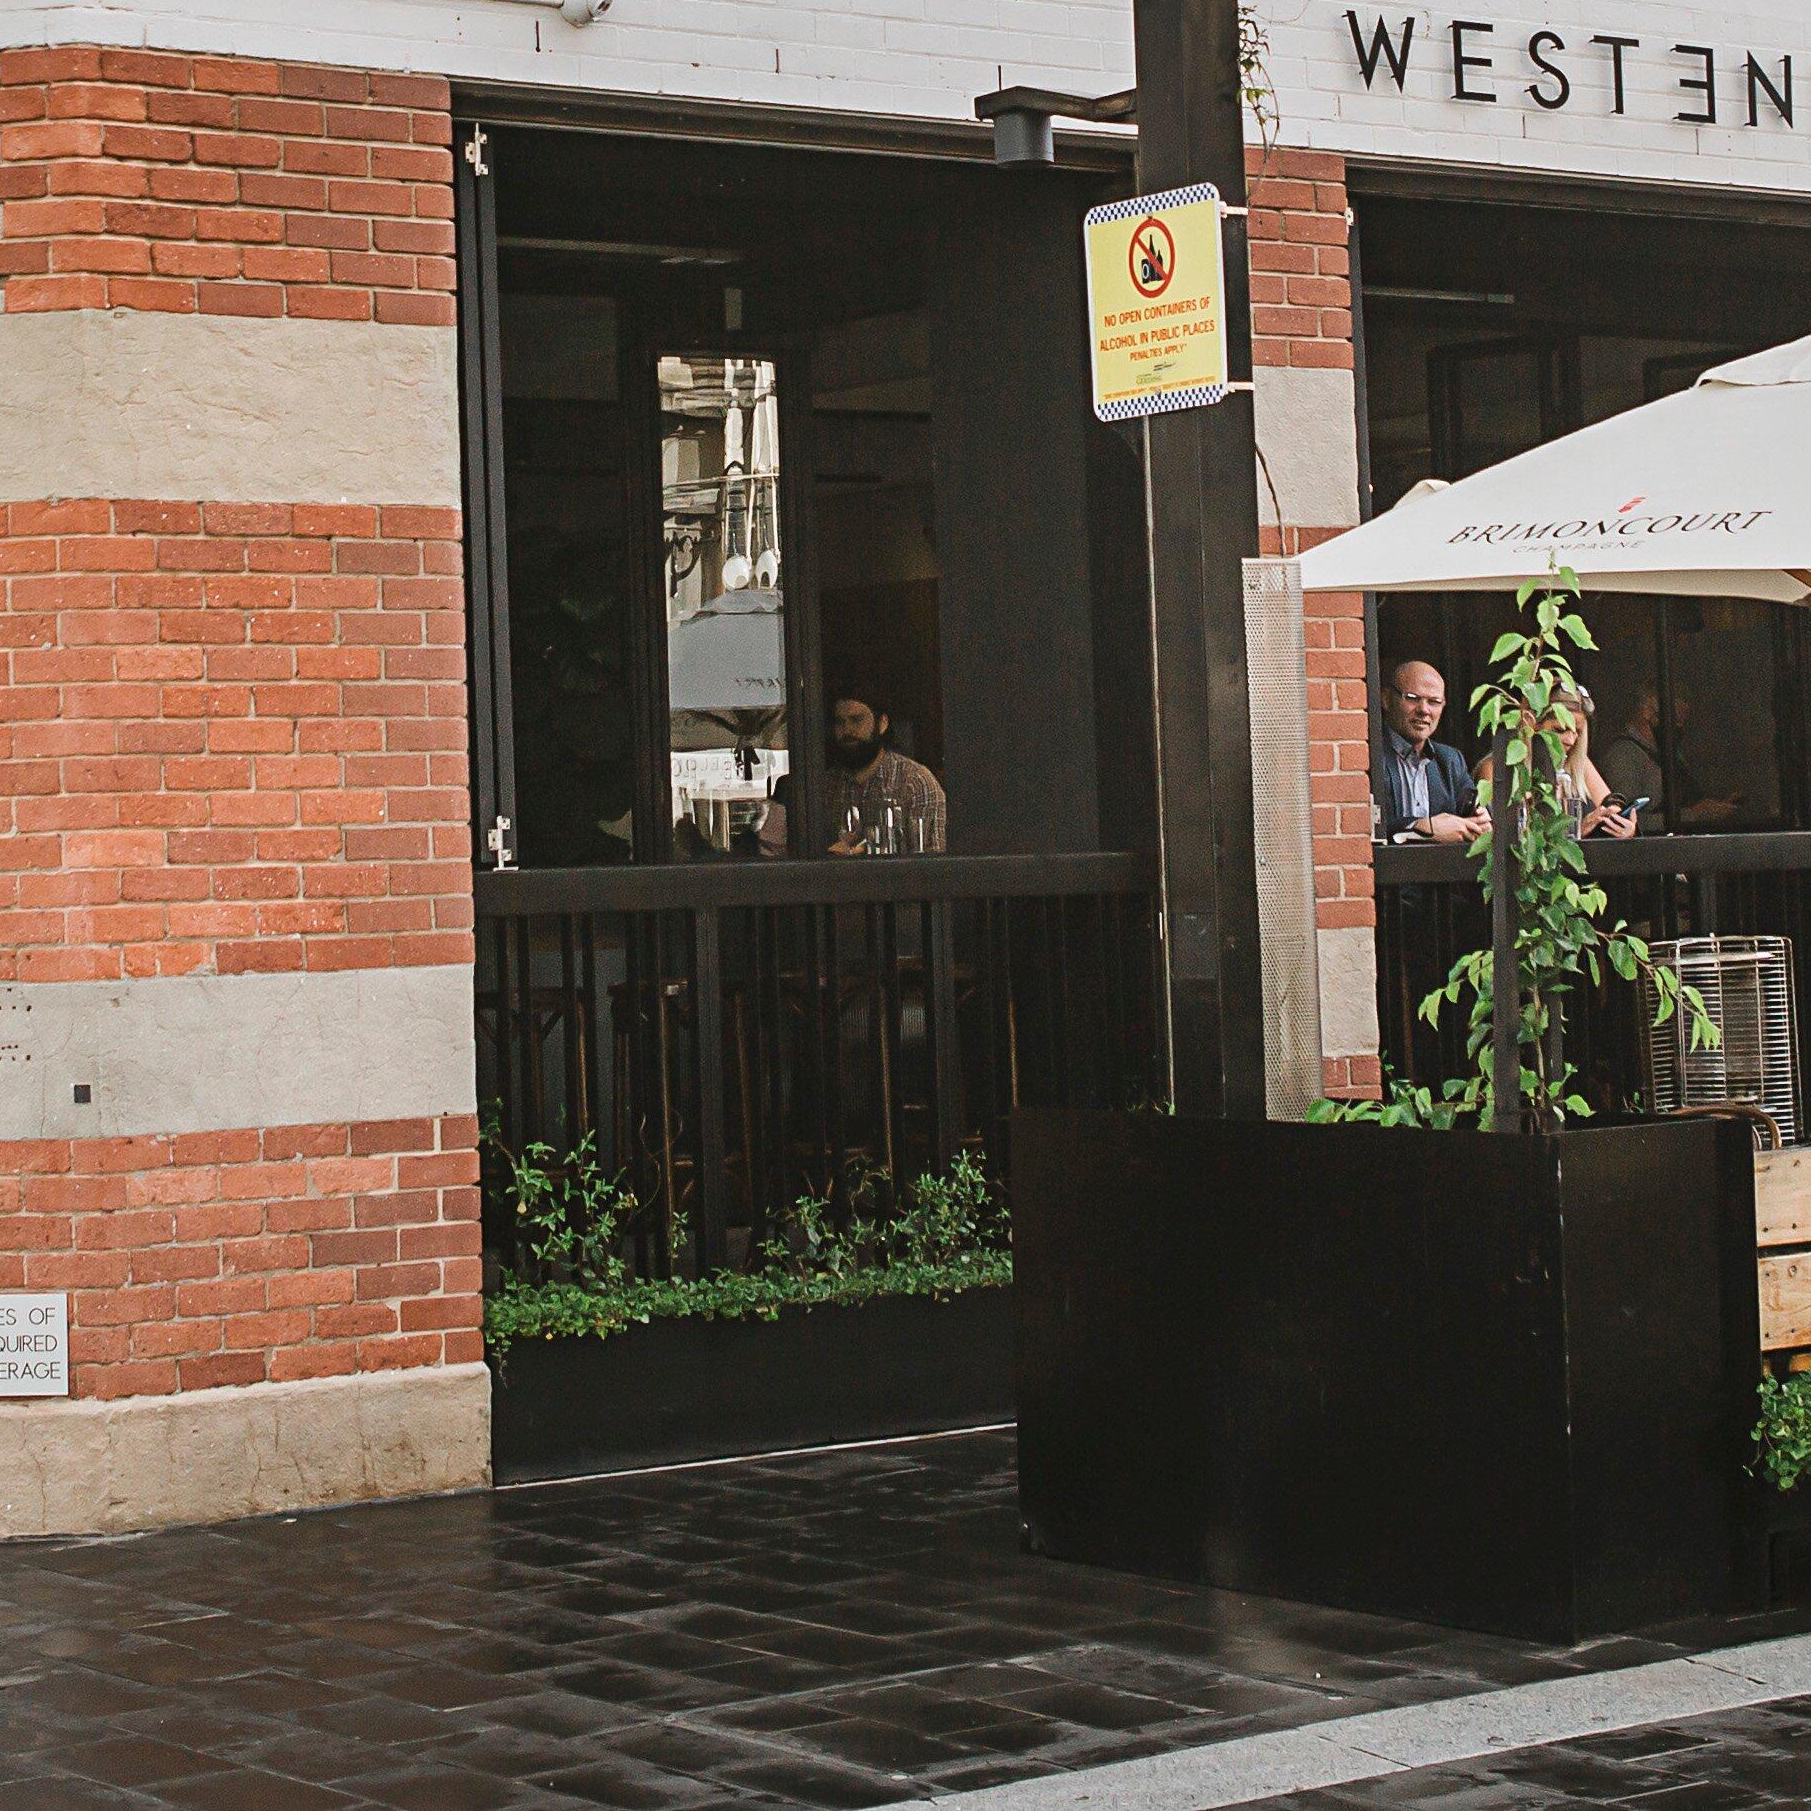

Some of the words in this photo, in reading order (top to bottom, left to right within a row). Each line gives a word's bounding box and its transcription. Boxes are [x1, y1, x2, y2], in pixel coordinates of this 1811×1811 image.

[1104, 314, 1116, 327] NO
[1119, 309, 1142, 325] OPEN
[1144, 298, 1197, 320] CONTAINERS
[1200, 296, 1210, 309] OF
[1100, 335, 1137, 352] ALCOHOL
[1140, 332, 1149, 344] IN
[1151, 326, 1180, 342] PUBLIC
[1182, 319, 1215, 336] PLACES
[1129, 347, 1162, 361] PENALTIES
[1445, 509, 1775, 545] BRIMONCOURT
[28, 1307, 56, 1325] OF
